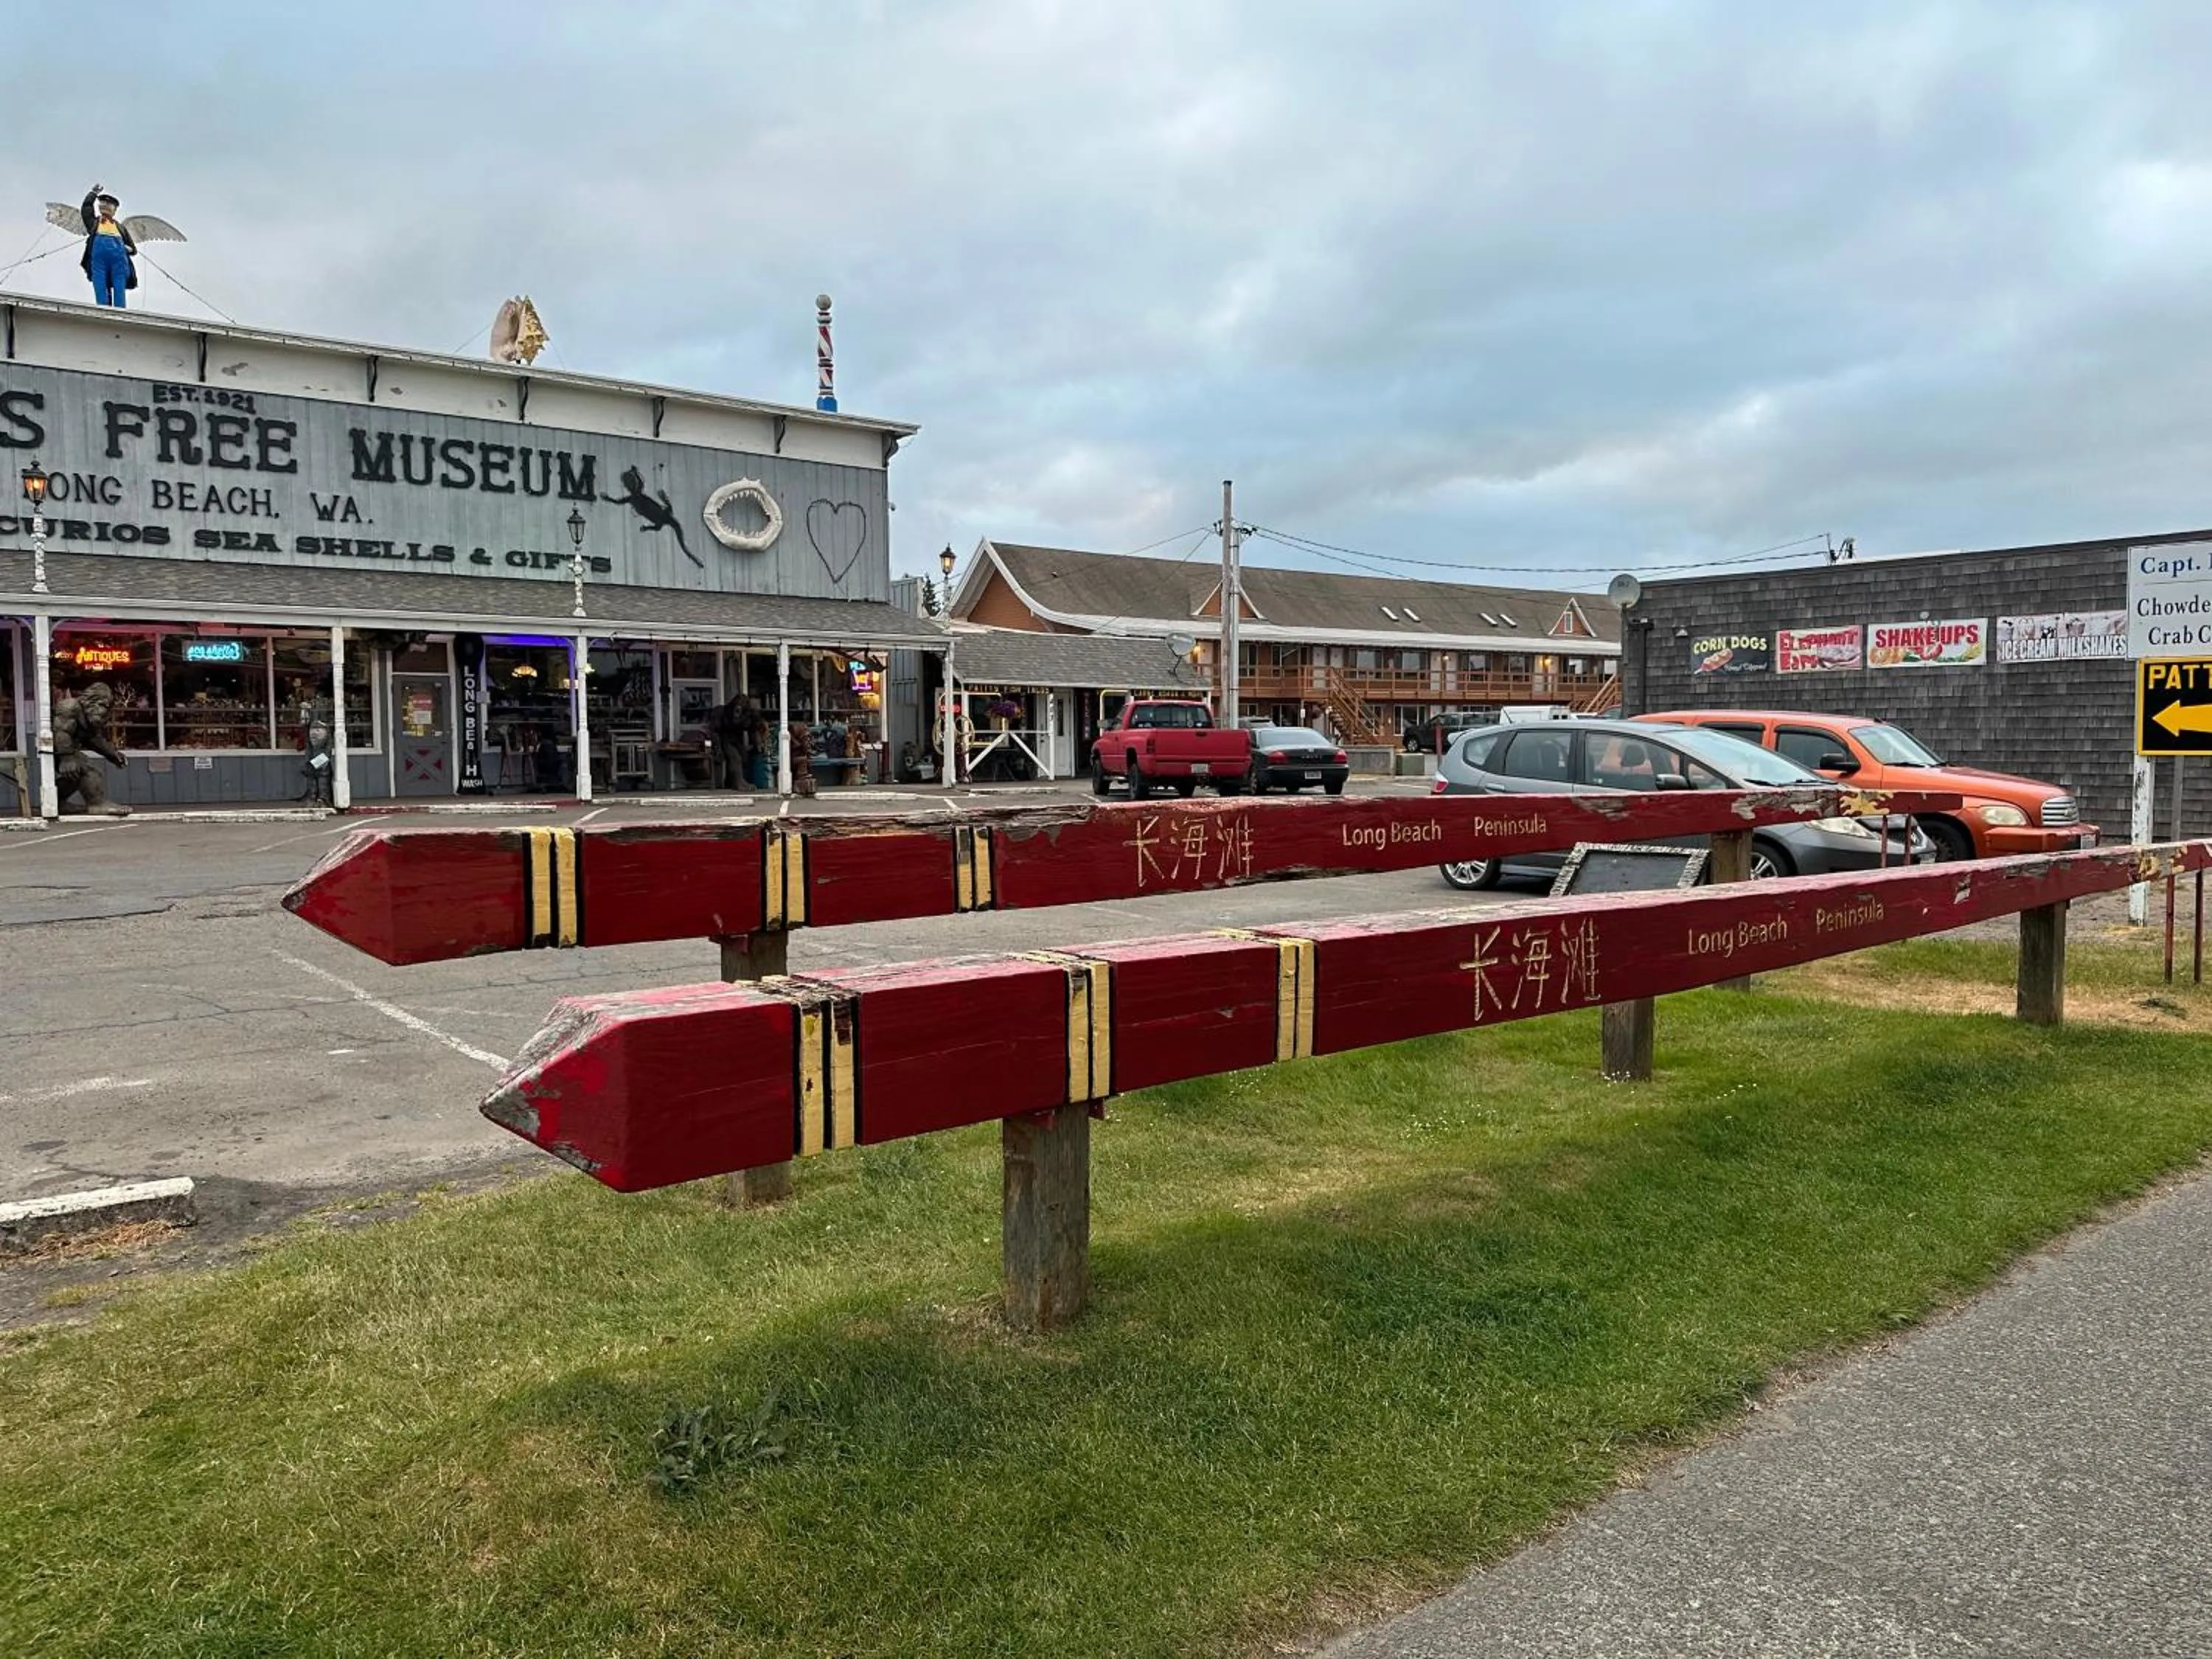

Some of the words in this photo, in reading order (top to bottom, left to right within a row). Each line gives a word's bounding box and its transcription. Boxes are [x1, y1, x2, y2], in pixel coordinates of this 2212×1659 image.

[153, 383, 200, 403] EST.
[204, 389, 257, 415] 1921
[103, 400, 298, 474] FREE
[349, 428, 597, 502] MUSEUM
[23, 471, 122, 505] ONG
[310, 492, 374, 524] WA.
[194, 529, 282, 553] SEA
[296, 535, 456, 563] SHELLS
[470, 547, 493, 566] &
[2140, 557, 2201, 578] Capt.
[1693, 636, 1727, 654] CORN
[1731, 636, 1767, 651] DOGS
[2002, 640, 2018, 660] ICE
[2020, 637, 2056, 659] CREAM
[2058, 634, 2126, 658] MILKSHAKES
[2148, 625, 2194, 646] Crab
[1342, 824, 1386, 851] Long
[1391, 818, 1441, 843] Beach
[1475, 813, 1547, 837] Peninsula
[1688, 928, 1733, 959] Long
[1738, 912, 1788, 947] Beach
[1816, 897, 1885, 934] Peninsula
